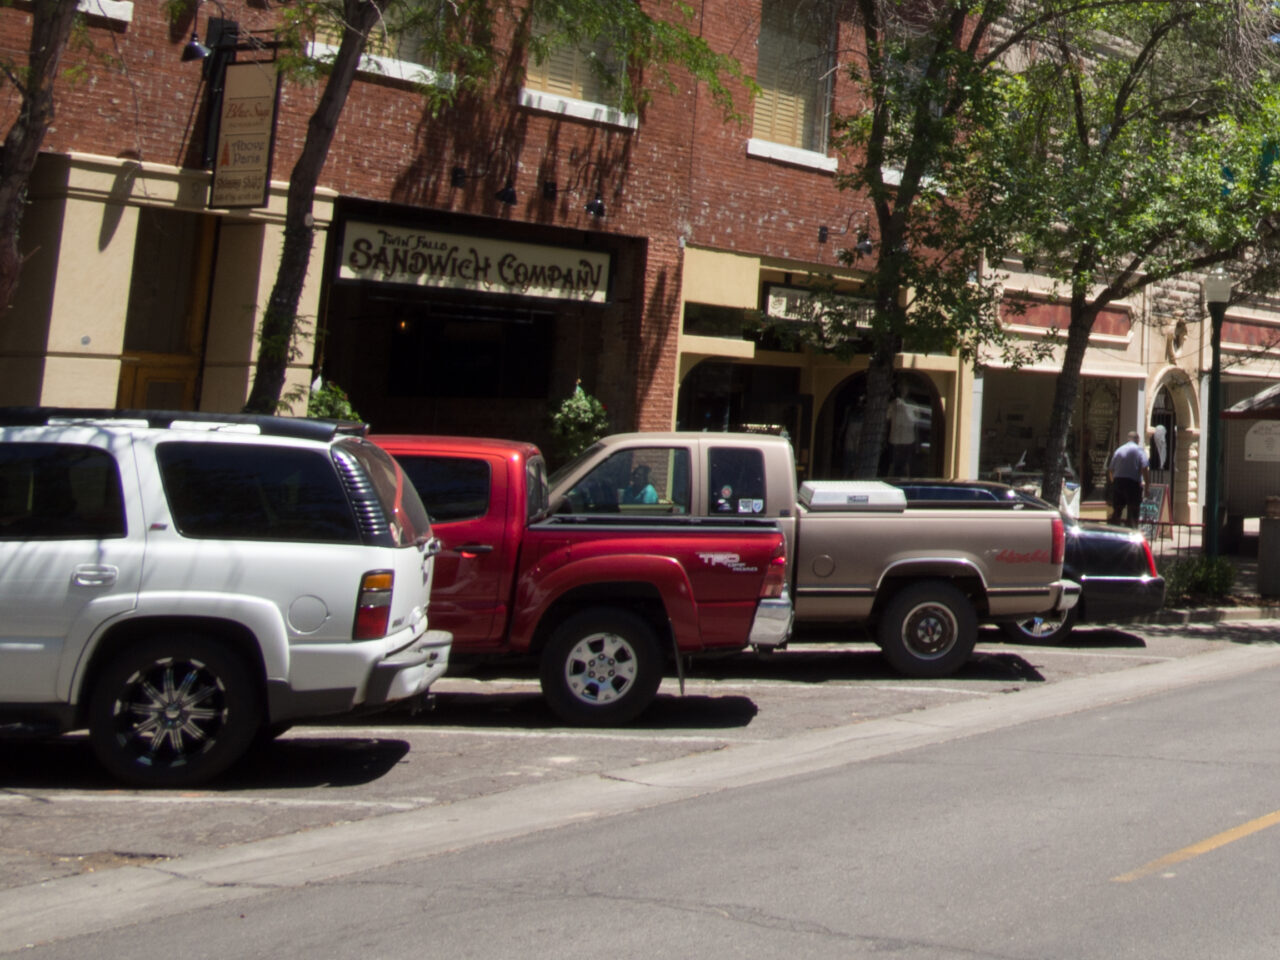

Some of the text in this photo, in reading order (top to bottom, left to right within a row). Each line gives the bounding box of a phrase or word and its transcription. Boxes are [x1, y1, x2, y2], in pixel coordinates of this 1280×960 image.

[377, 230, 448, 251] TWIN FALLS
[350, 238, 603, 300] SANDWICH COMPANY
